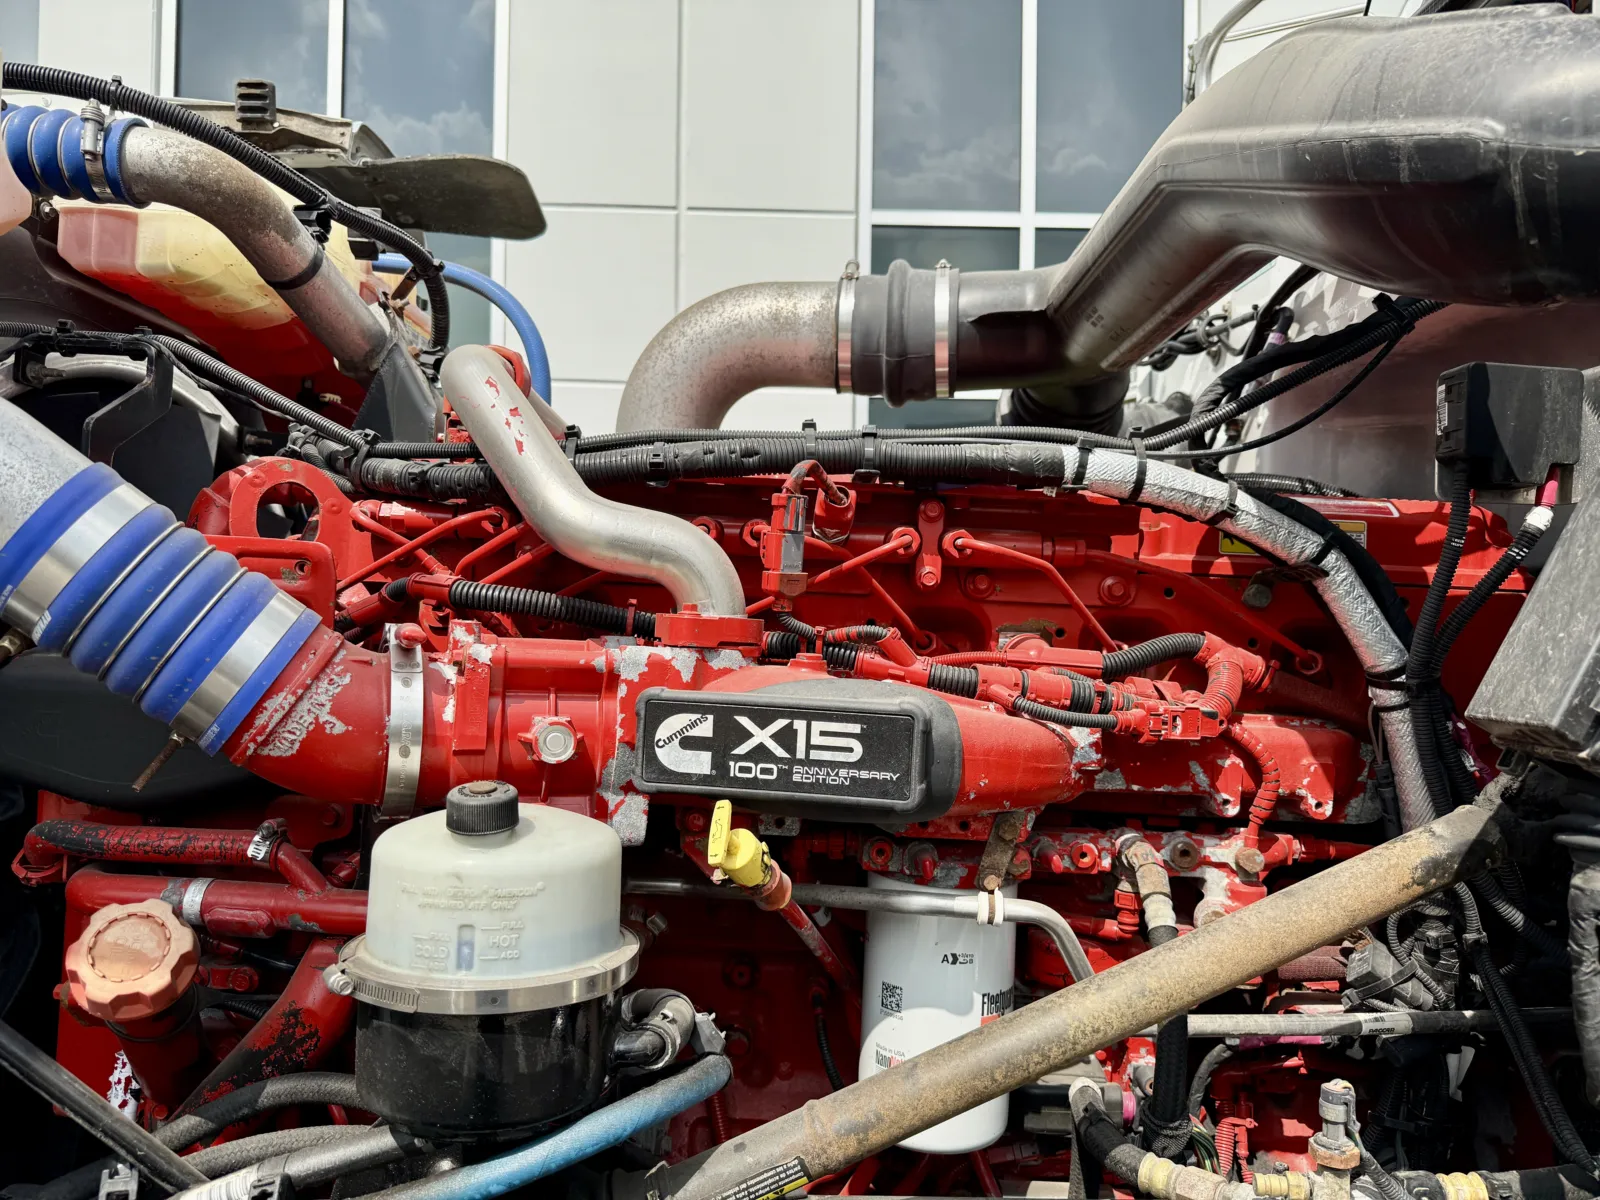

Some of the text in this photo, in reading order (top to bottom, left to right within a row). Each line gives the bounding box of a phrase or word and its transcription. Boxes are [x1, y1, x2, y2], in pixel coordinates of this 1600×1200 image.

[655, 714, 709, 749] Cummins
[792, 765, 900, 781] ANNIVERSARY
[792, 773, 850, 785] EDITION
[489, 933, 520, 949] HOT
[414, 943, 449, 960] COLD
[941, 954, 950, 964] A
[893, 1050, 905, 1058] USA
